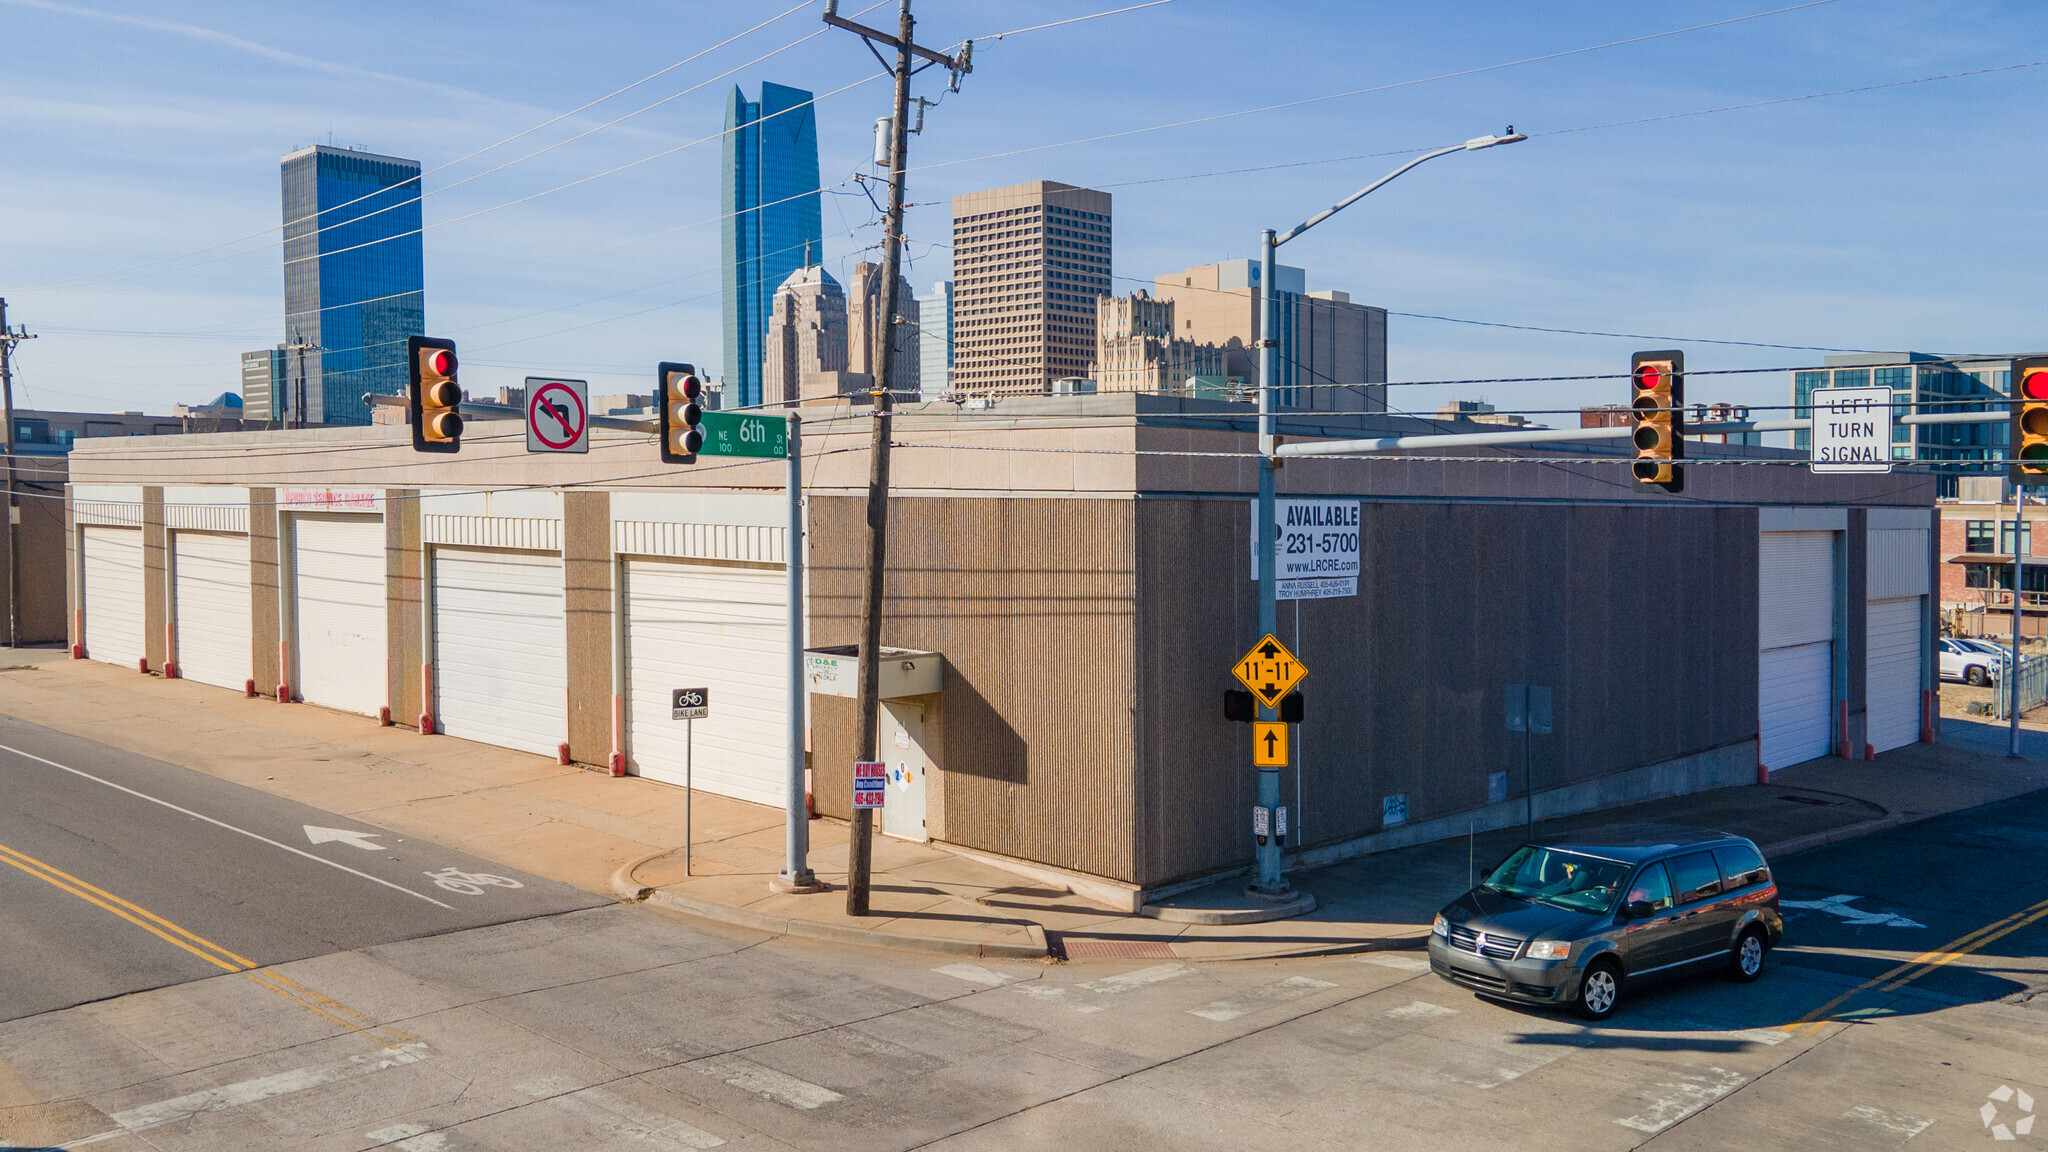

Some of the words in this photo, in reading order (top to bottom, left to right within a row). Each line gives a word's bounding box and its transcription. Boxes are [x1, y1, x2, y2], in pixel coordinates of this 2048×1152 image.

[1831, 398, 1873, 414] LEFT
[718, 431, 728, 441] NE
[740, 419, 765, 443] 6th
[1829, 422, 1874, 438] TURN
[776, 434, 783, 444] St
[719, 443, 732, 453] 100
[1821, 446, 1883, 461] SIGNAL
[313, 491, 342, 507] SERVICE
[344, 492, 375, 507] GARAGE
[1286, 505, 1358, 526] AVAILABLE
[1286, 533, 1358, 553] 231-5700
[1286, 559, 1358, 572] www.LRCRE.com
[1281, 582, 1296, 590] ANNA
[1297, 581, 1319, 589] RUSSELL
[1294, 589, 1322, 597] HUMPHREY
[674, 709, 689, 718] BIKE
[690, 708, 706, 717] LANE
[895, 769, 900, 781] 2
